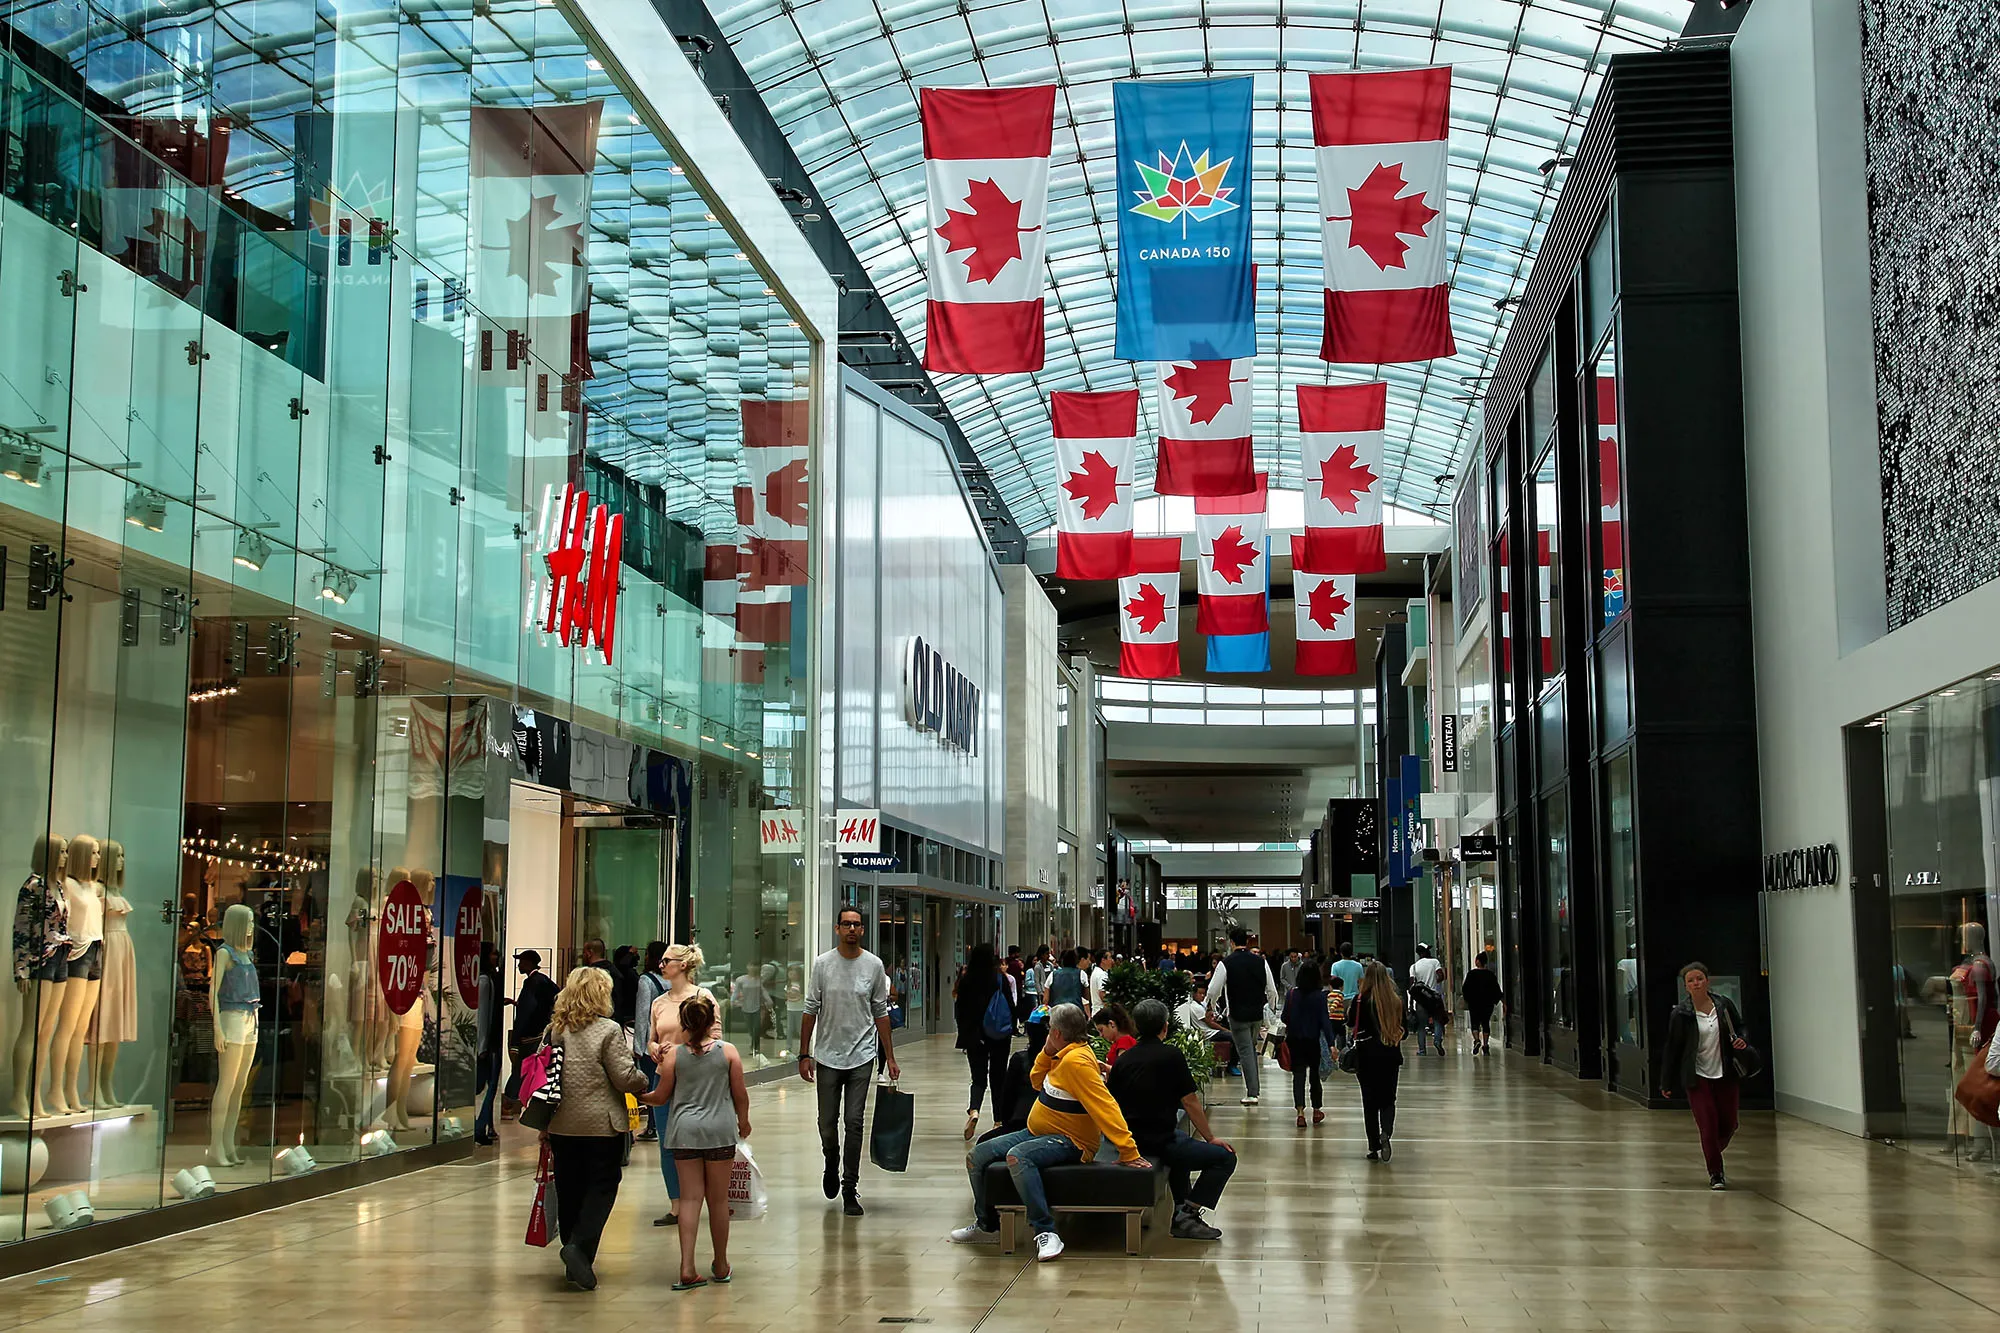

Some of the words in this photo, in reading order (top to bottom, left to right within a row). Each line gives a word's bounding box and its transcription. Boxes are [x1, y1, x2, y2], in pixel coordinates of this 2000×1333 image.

[1139, 247, 1201, 261] CANADA
[1205, 246, 1231, 258] 150
[911, 635, 944, 733] OLD
[945, 660, 981, 759] NAVY
[1446, 760, 1454, 771] LE
[839, 818, 877, 844] H&M
[852, 857, 869, 866] OLD
[869, 857, 894, 866] NAVY
[1763, 842, 1839, 892] MARCIANO
[1315, 901, 1337, 909] GUEST
[1339, 901, 1380, 909] SERVICES
[386, 903, 421, 934] SALE
[387, 954, 418, 991] 70%
[730, 1170, 751, 1180] OUVRE
[728, 1180, 738, 1190] UR
[738, 1181, 746, 1190] LE
[728, 1190, 750, 1200] ANADA
